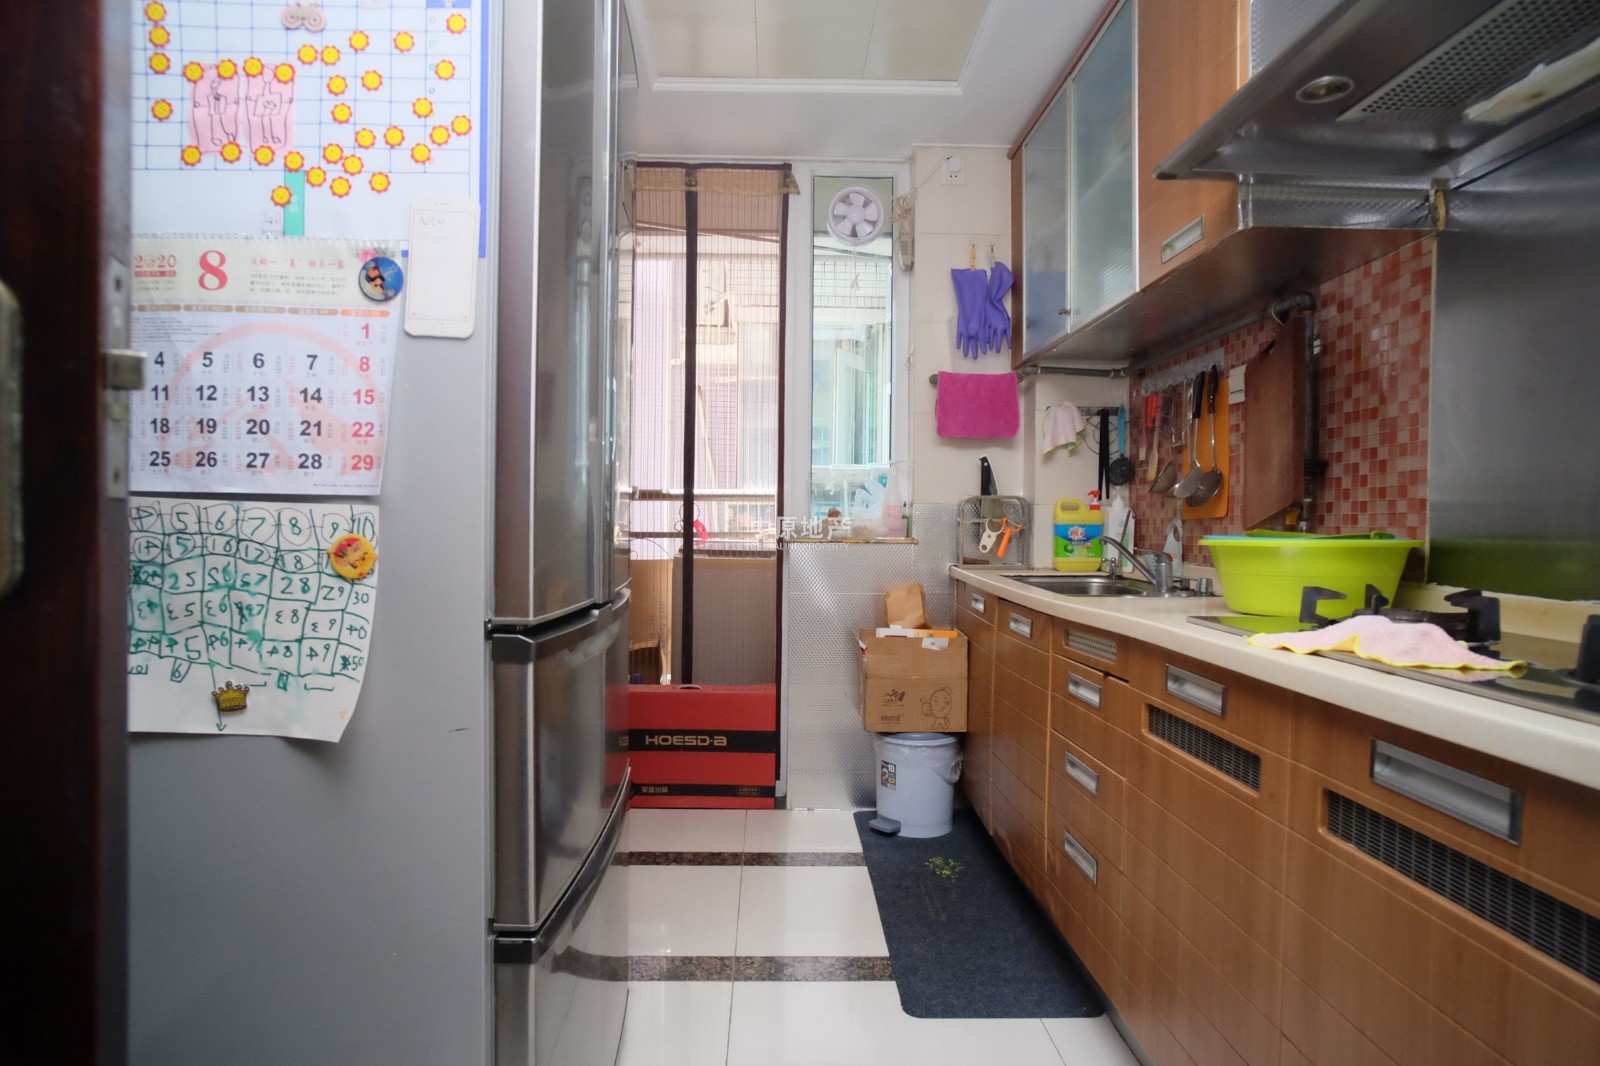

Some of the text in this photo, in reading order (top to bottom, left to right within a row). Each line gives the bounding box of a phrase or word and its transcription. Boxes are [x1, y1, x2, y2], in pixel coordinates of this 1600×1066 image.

[198, 249, 229, 292] 8
[361, 323, 370, 339] 1
[154, 352, 165, 367] 4
[202, 351, 213, 368] 5
[252, 353, 265, 368] 6
[306, 355, 318, 370] 7
[359, 356, 370, 372] 8
[151, 384, 169, 401] 11
[195, 384, 217, 401] 12
[246, 386, 270, 402] 13
[300, 387, 322, 403] 14
[352, 389, 375, 405] 15
[150, 417, 170, 434] 18
[196, 418, 217, 434] 19
[246, 419, 270, 435] 20
[300, 420, 322, 437] 21
[352, 421, 375, 438] 22
[149, 451, 171, 467] 25
[195, 451, 218, 468] 26
[246, 452, 270, 469] 27
[298, 453, 322, 470] 28
[351, 454, 374, 471] 29
[175, 511, 189, 532] 5
[214, 510, 226, 531] 6
[247, 516, 266, 537] 7
[289, 516, 302, 536] 8
[330, 521, 339, 539] 9
[167, 570, 196, 590] 25
[280, 576, 311, 595] 28
[352, 590, 370, 606] 30
